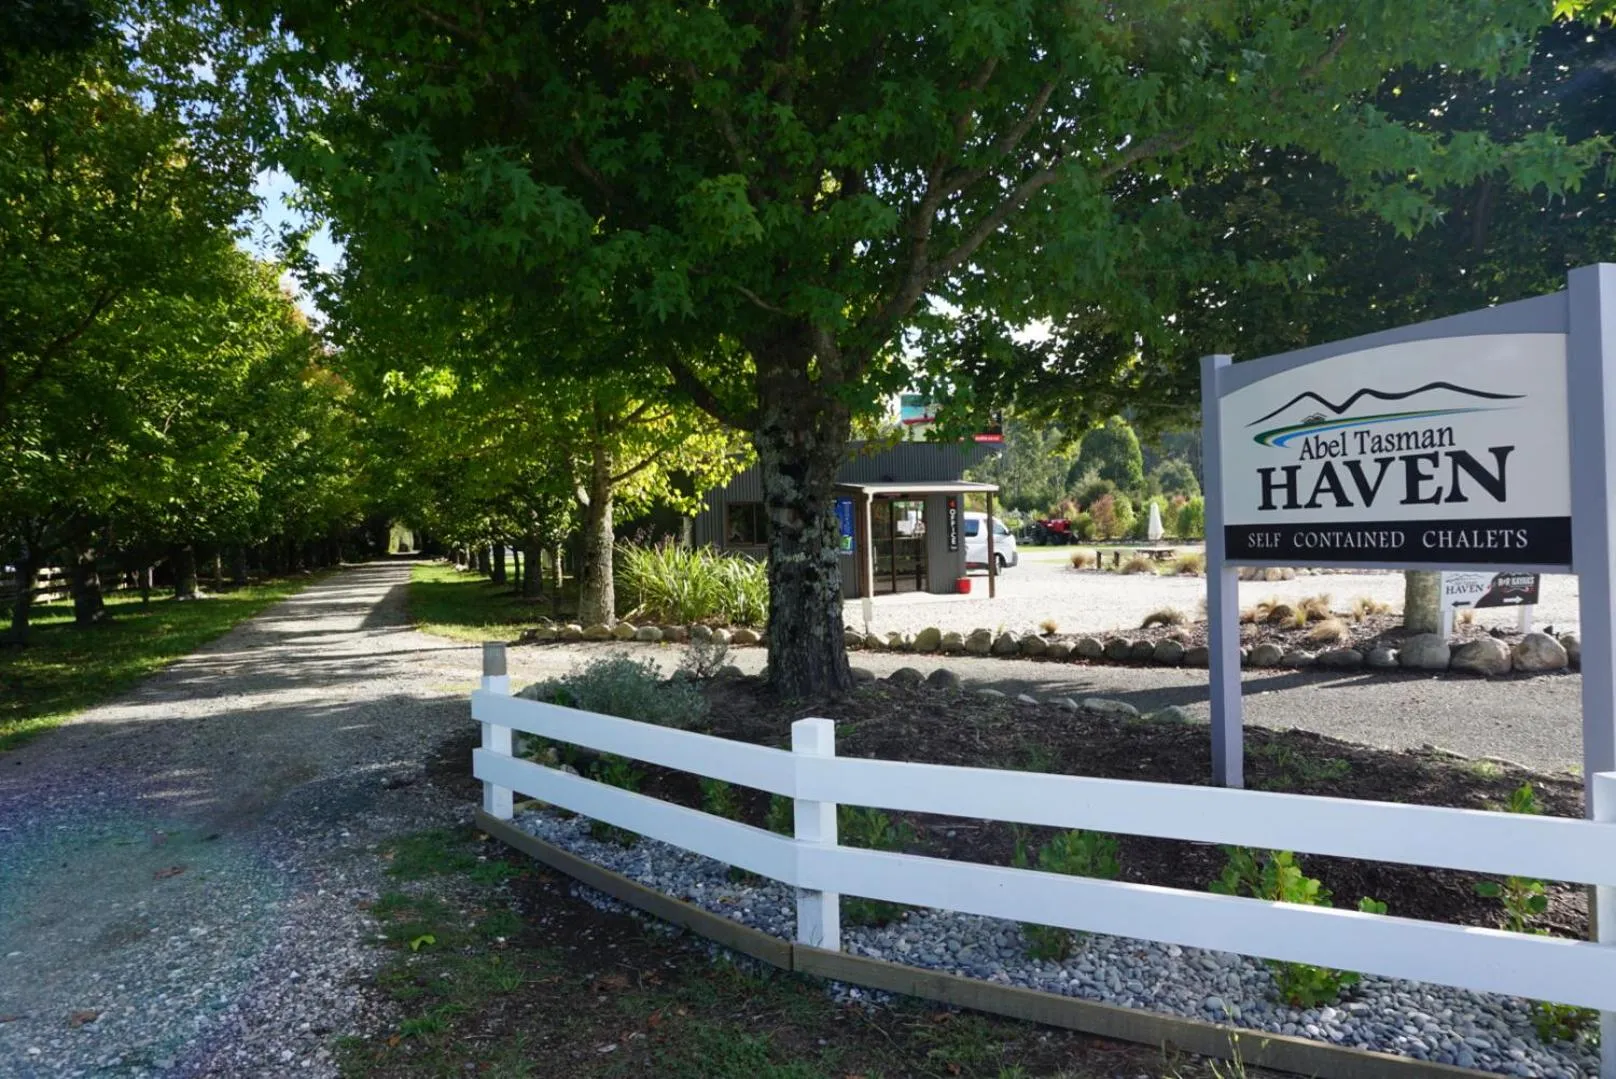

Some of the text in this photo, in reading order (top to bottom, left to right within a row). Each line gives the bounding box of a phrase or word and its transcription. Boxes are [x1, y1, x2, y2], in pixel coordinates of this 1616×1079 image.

[1299, 426, 1455, 460] Abel Tasman
[1257, 446, 1515, 511] HAVEN
[949, 508, 957, 545] OFFICE
[1248, 529, 1529, 548] SELF CONTAINED CHALETS
[1446, 584, 1484, 595] HAVEN
